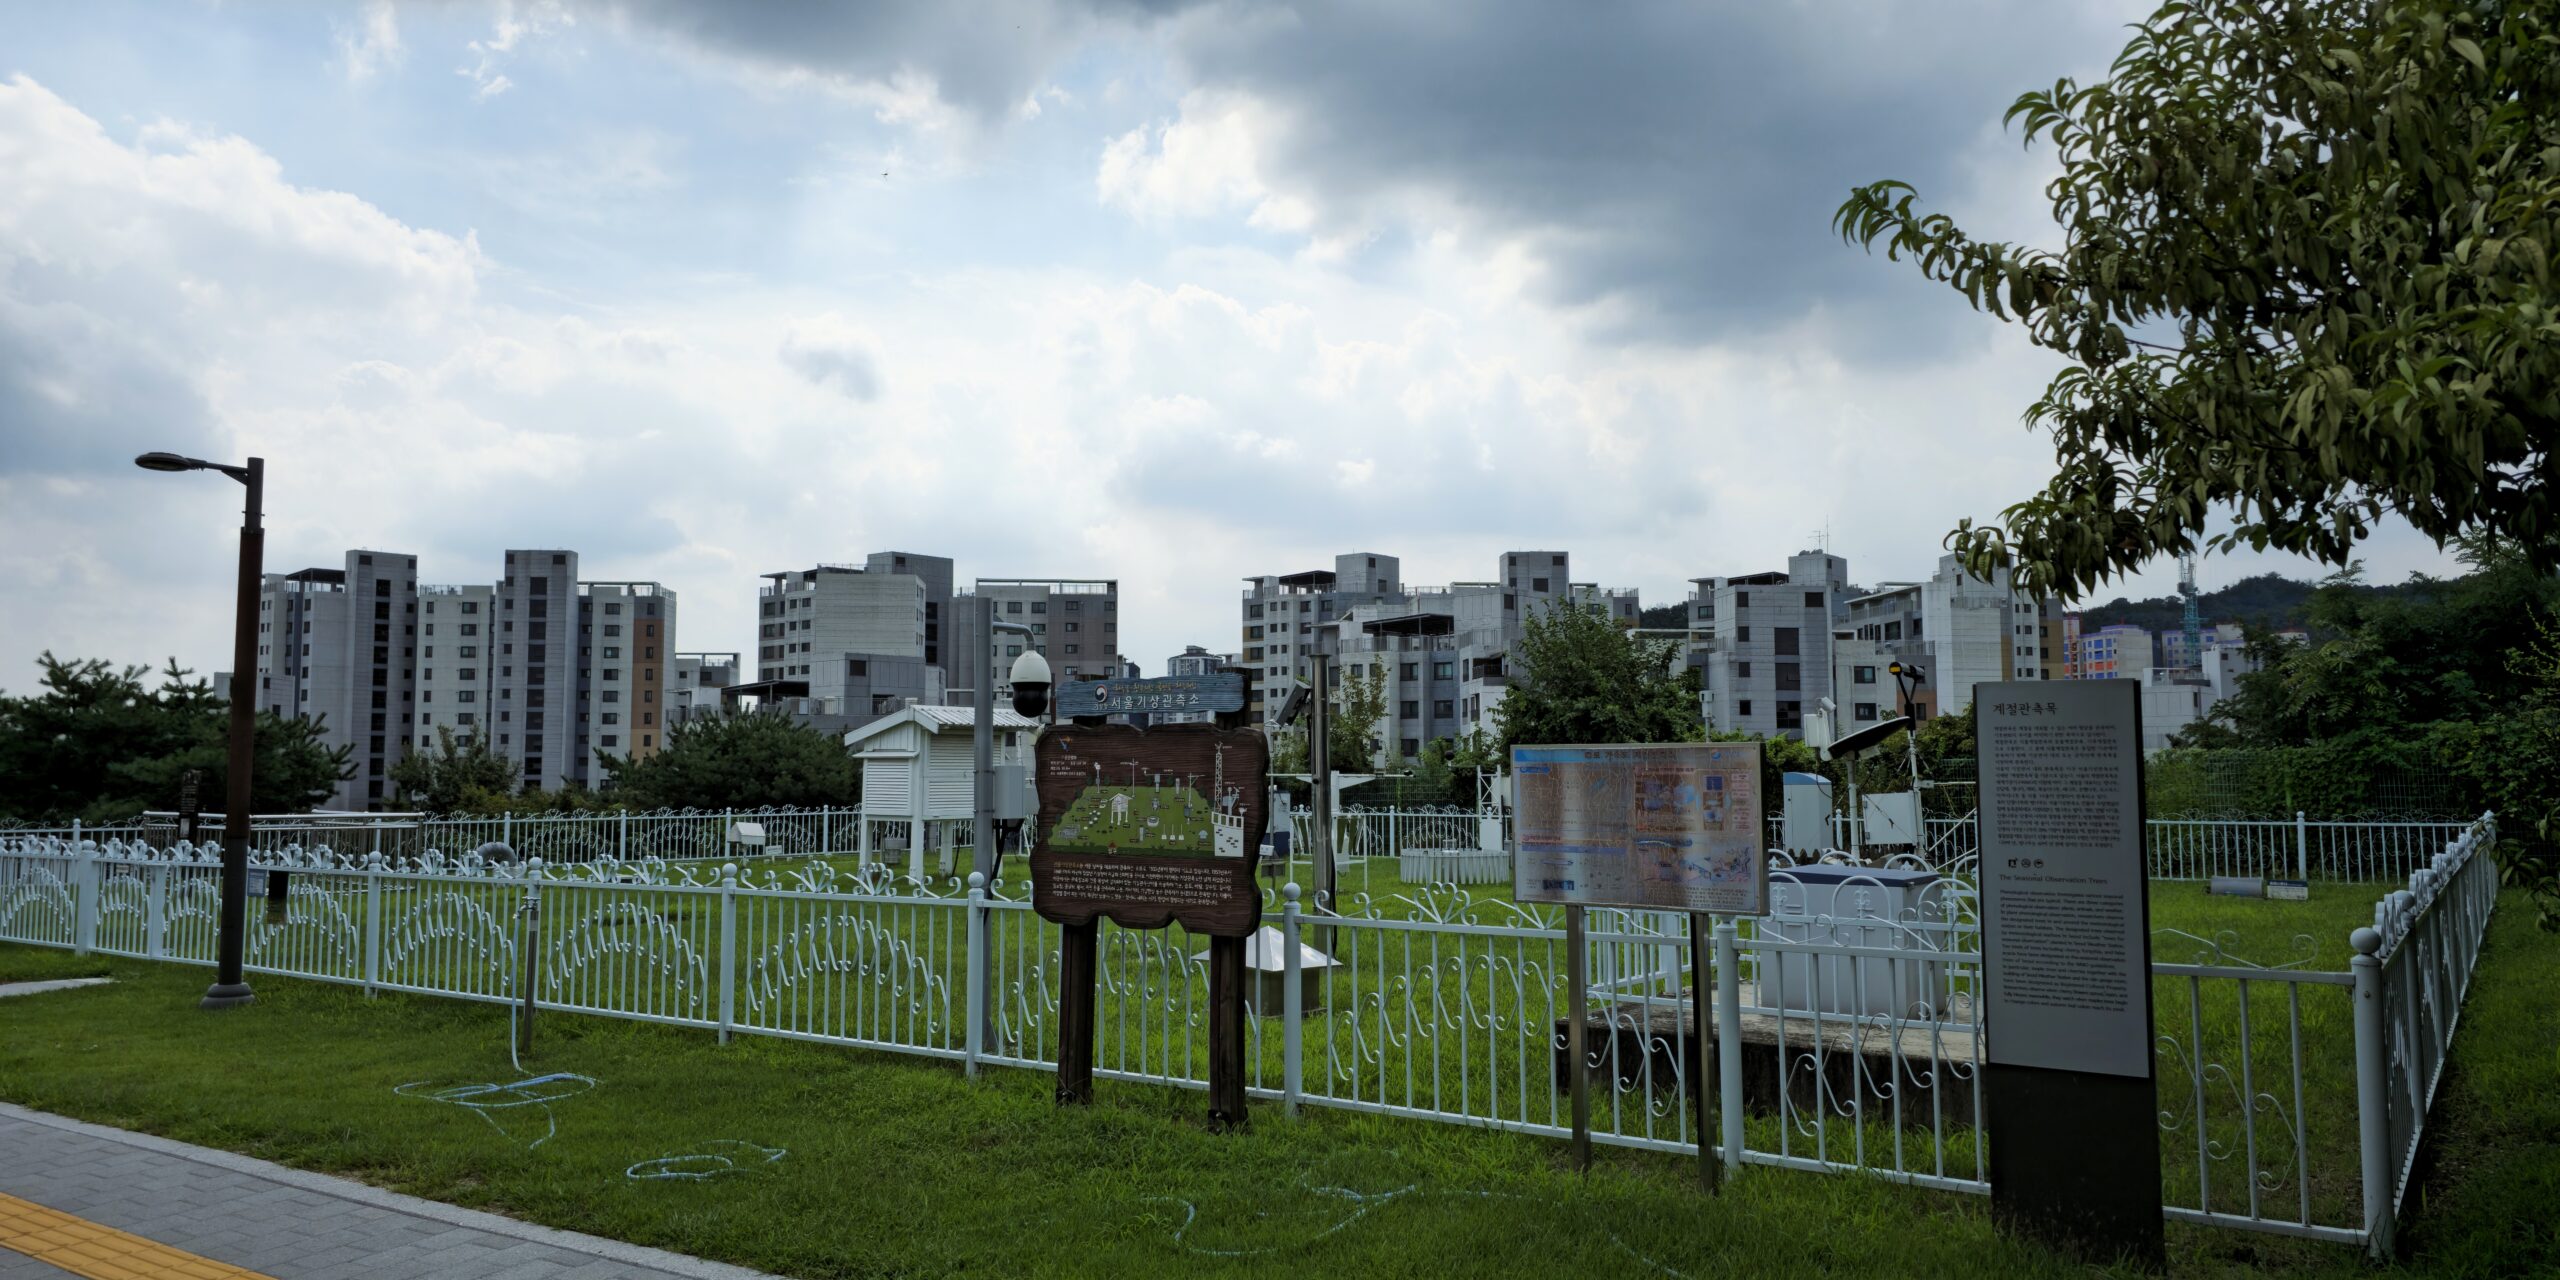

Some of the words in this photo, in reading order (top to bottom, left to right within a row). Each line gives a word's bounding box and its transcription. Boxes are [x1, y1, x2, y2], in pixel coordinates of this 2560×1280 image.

[1111, 693, 1199, 710] 서울기상관측소
[1993, 702, 2057, 716] 계절관측목
[2045, 876, 2087, 884] Observation
[2088, 877, 2108, 885] Trees
